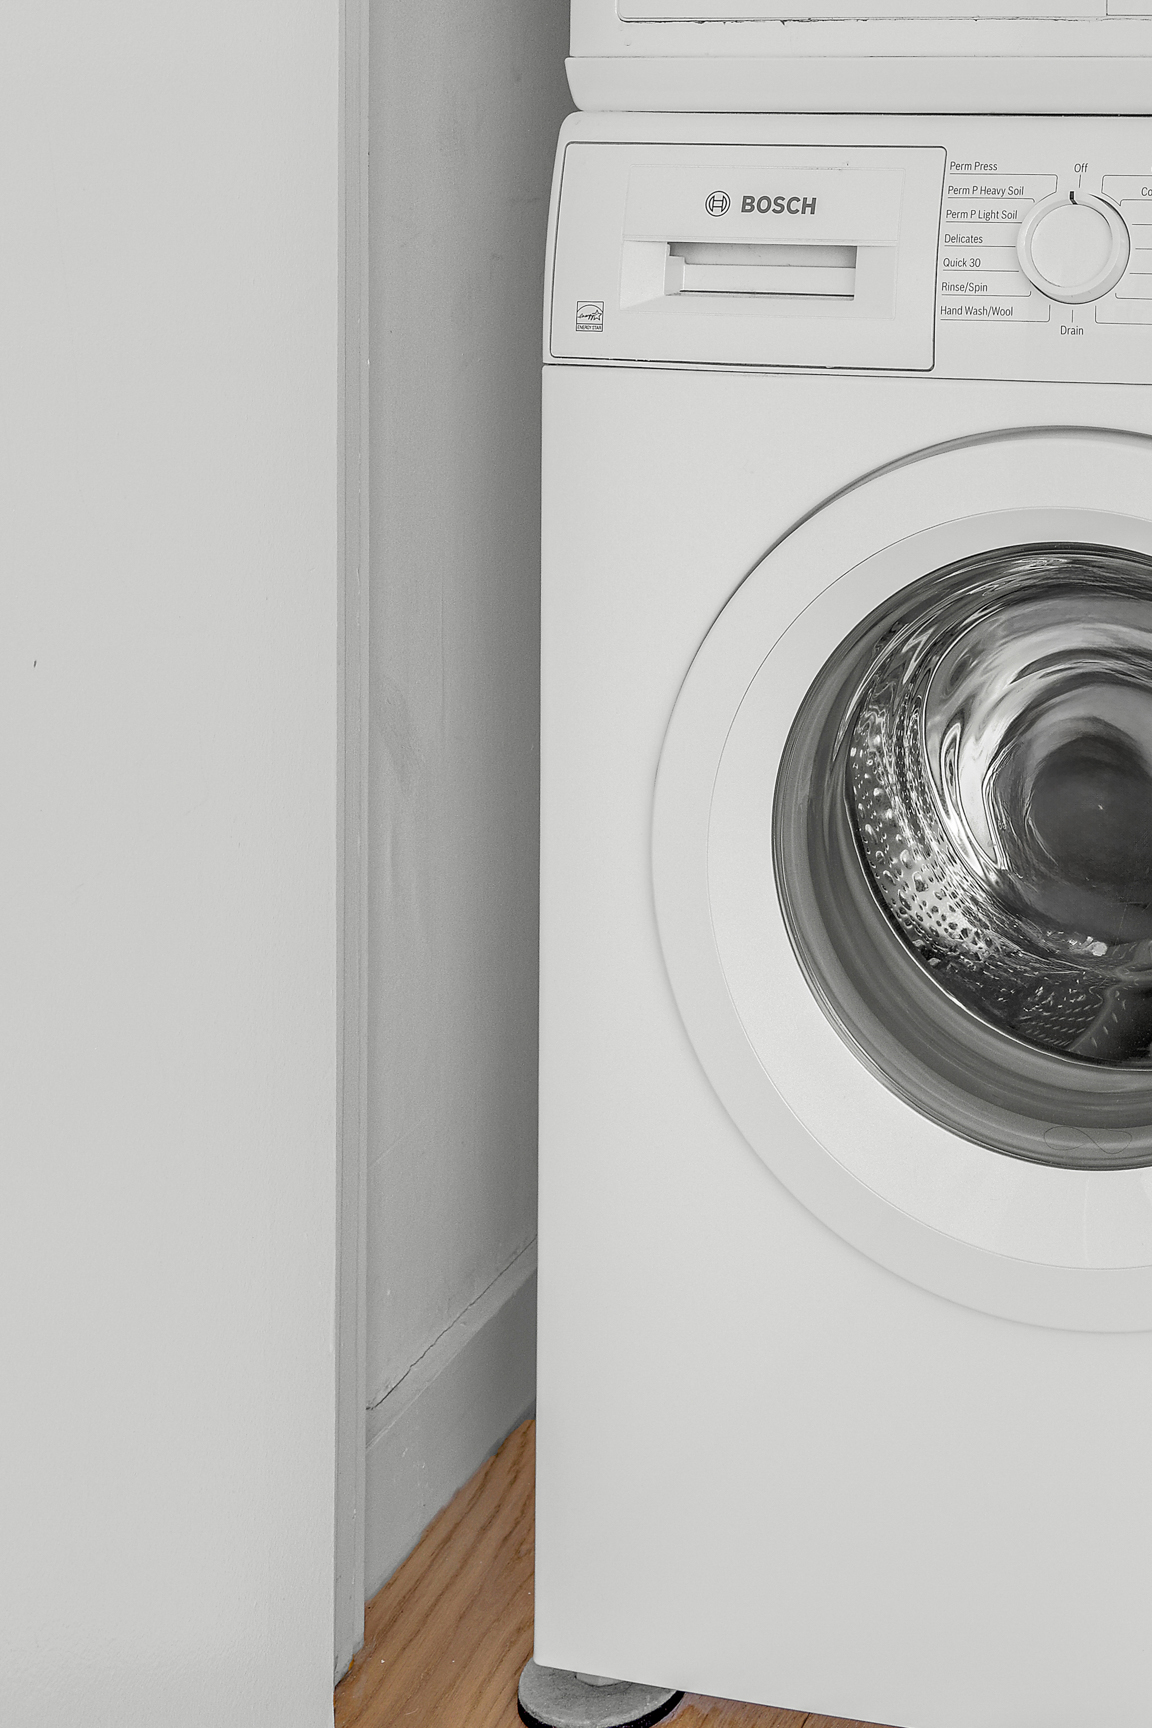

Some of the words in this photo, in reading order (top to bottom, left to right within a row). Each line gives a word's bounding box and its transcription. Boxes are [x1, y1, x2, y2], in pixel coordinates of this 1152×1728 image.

[950, 162, 972, 170] Perm
[974, 162, 998, 171] Press
[1074, 163, 1088, 172] Off
[948, 186, 970, 194] Perm
[972, 186, 978, 194] P
[980, 186, 1006, 197] Heavy
[1008, 186, 1024, 196] Soil
[741, 195, 816, 214] BOSCH
[946, 210, 968, 218] Perm
[970, 210, 976, 218] P
[978, 210, 1000, 221] Light
[1001, 210, 1018, 220] Soil
[944, 234, 983, 244] Delicates
[943, 258, 968, 268] Quick
[969, 258, 981, 268] 30
[942, 282, 988, 294] Rinse/Spin
[940, 306, 962, 316] Hand
[964, 306, 1014, 317] Wash/Wool
[1060, 326, 1084, 335] Drain
